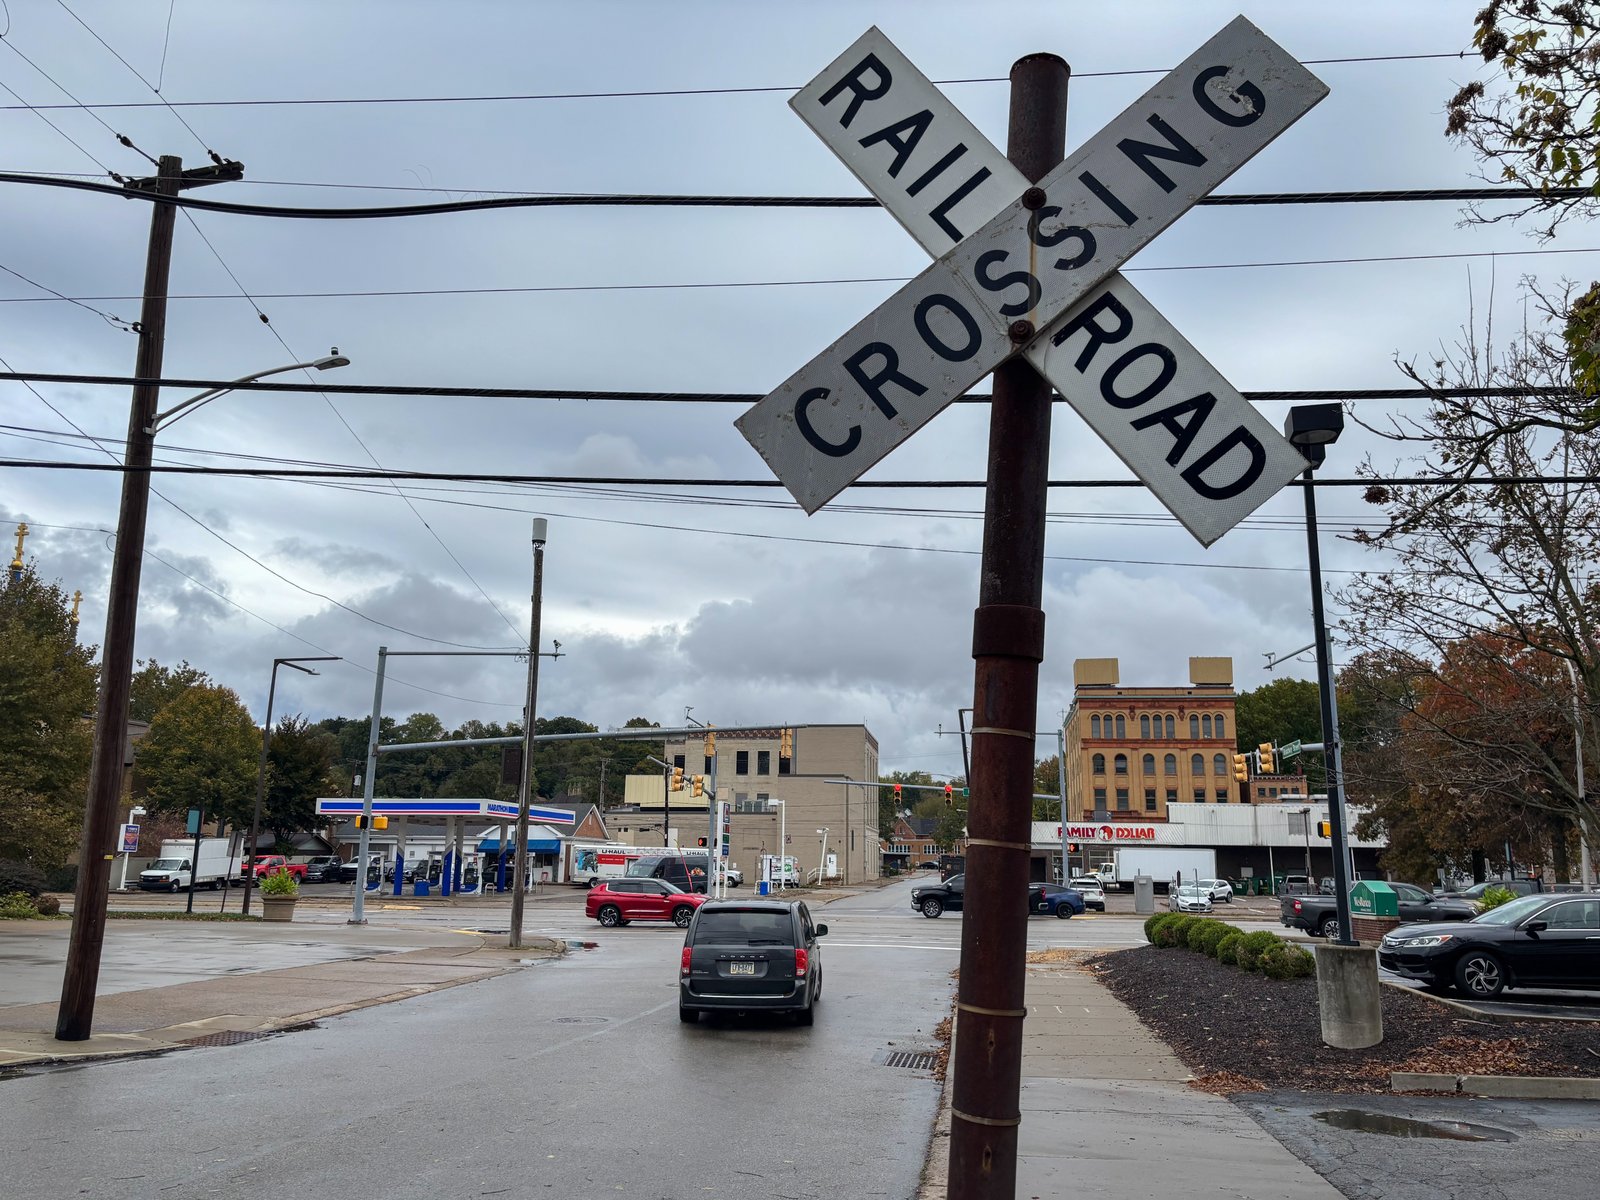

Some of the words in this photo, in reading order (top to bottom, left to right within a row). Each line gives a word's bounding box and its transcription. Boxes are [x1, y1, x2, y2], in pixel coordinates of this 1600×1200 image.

[818, 53, 992, 243] RAIL
[794, 65, 1266, 458] CROSSING
[1050, 291, 1267, 501] ROAD
[487, 803, 509, 813] MARATHON
[1116, 827, 1154, 839] DOLLAR
